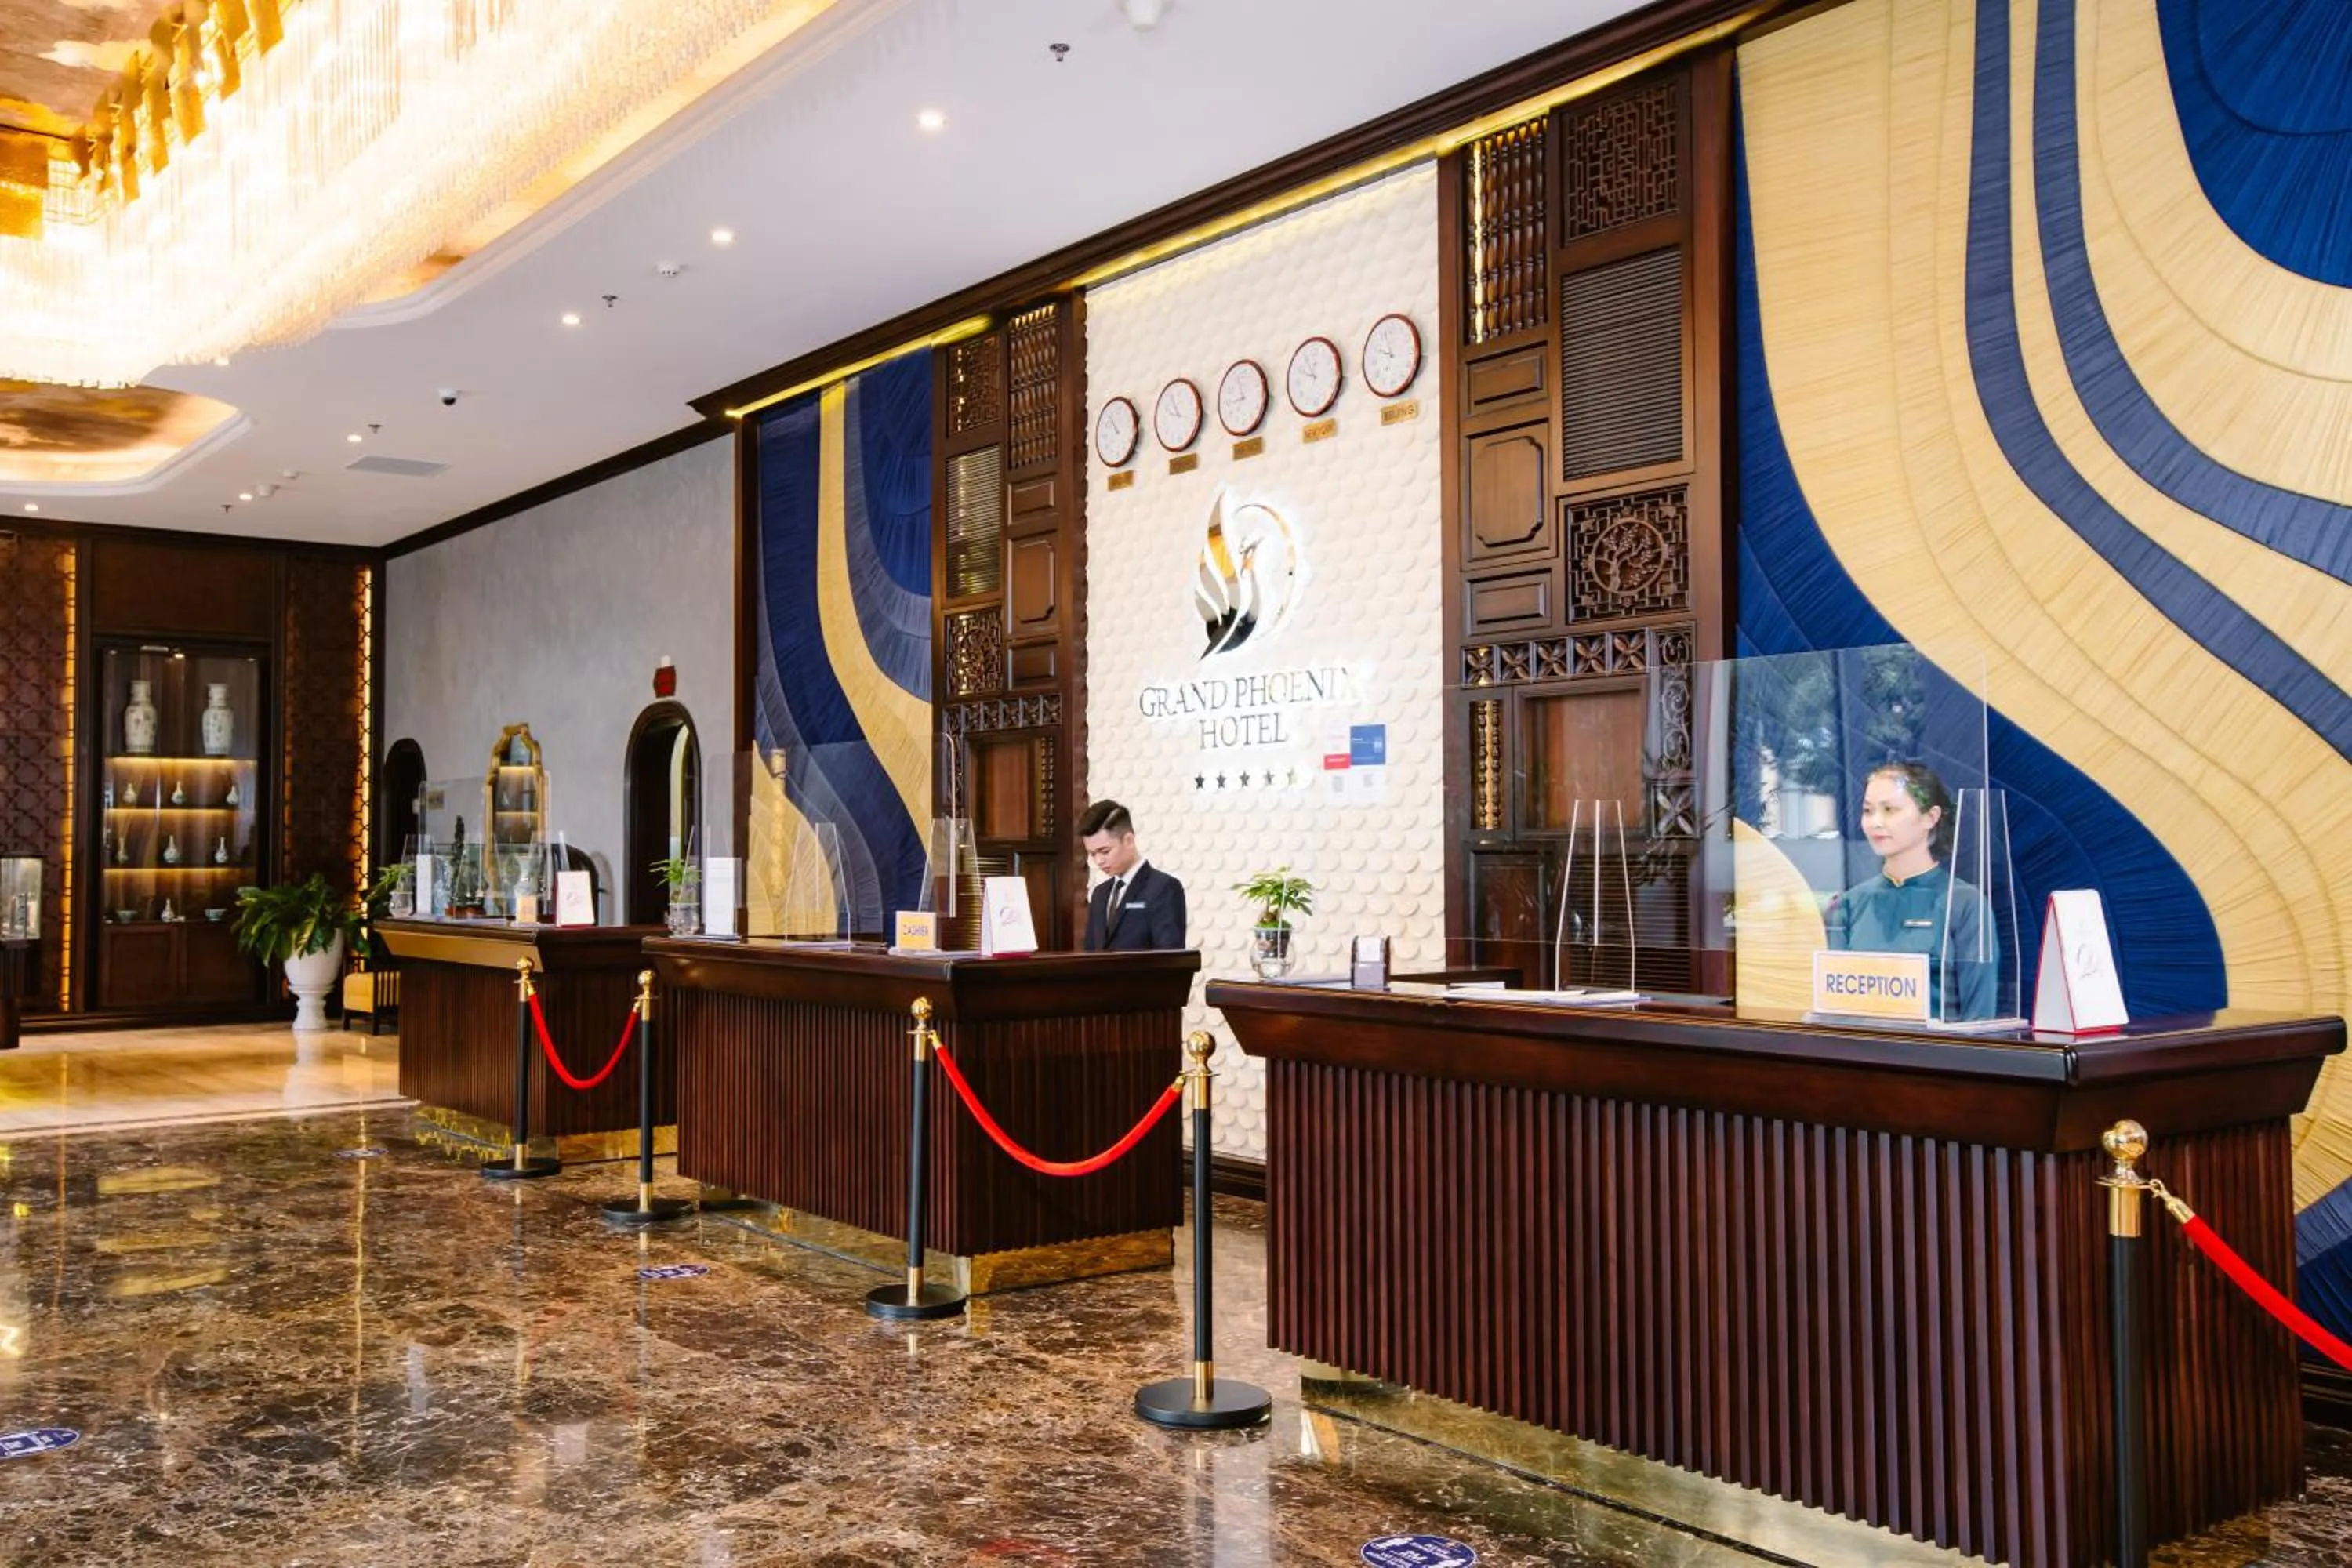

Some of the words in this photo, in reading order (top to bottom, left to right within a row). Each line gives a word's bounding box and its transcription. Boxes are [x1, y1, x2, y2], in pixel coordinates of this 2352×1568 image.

[1139, 680, 1229, 717] GRAND
[1198, 713, 1288, 750] HOTEL
[1825, 973, 1917, 998] RECEPTION
